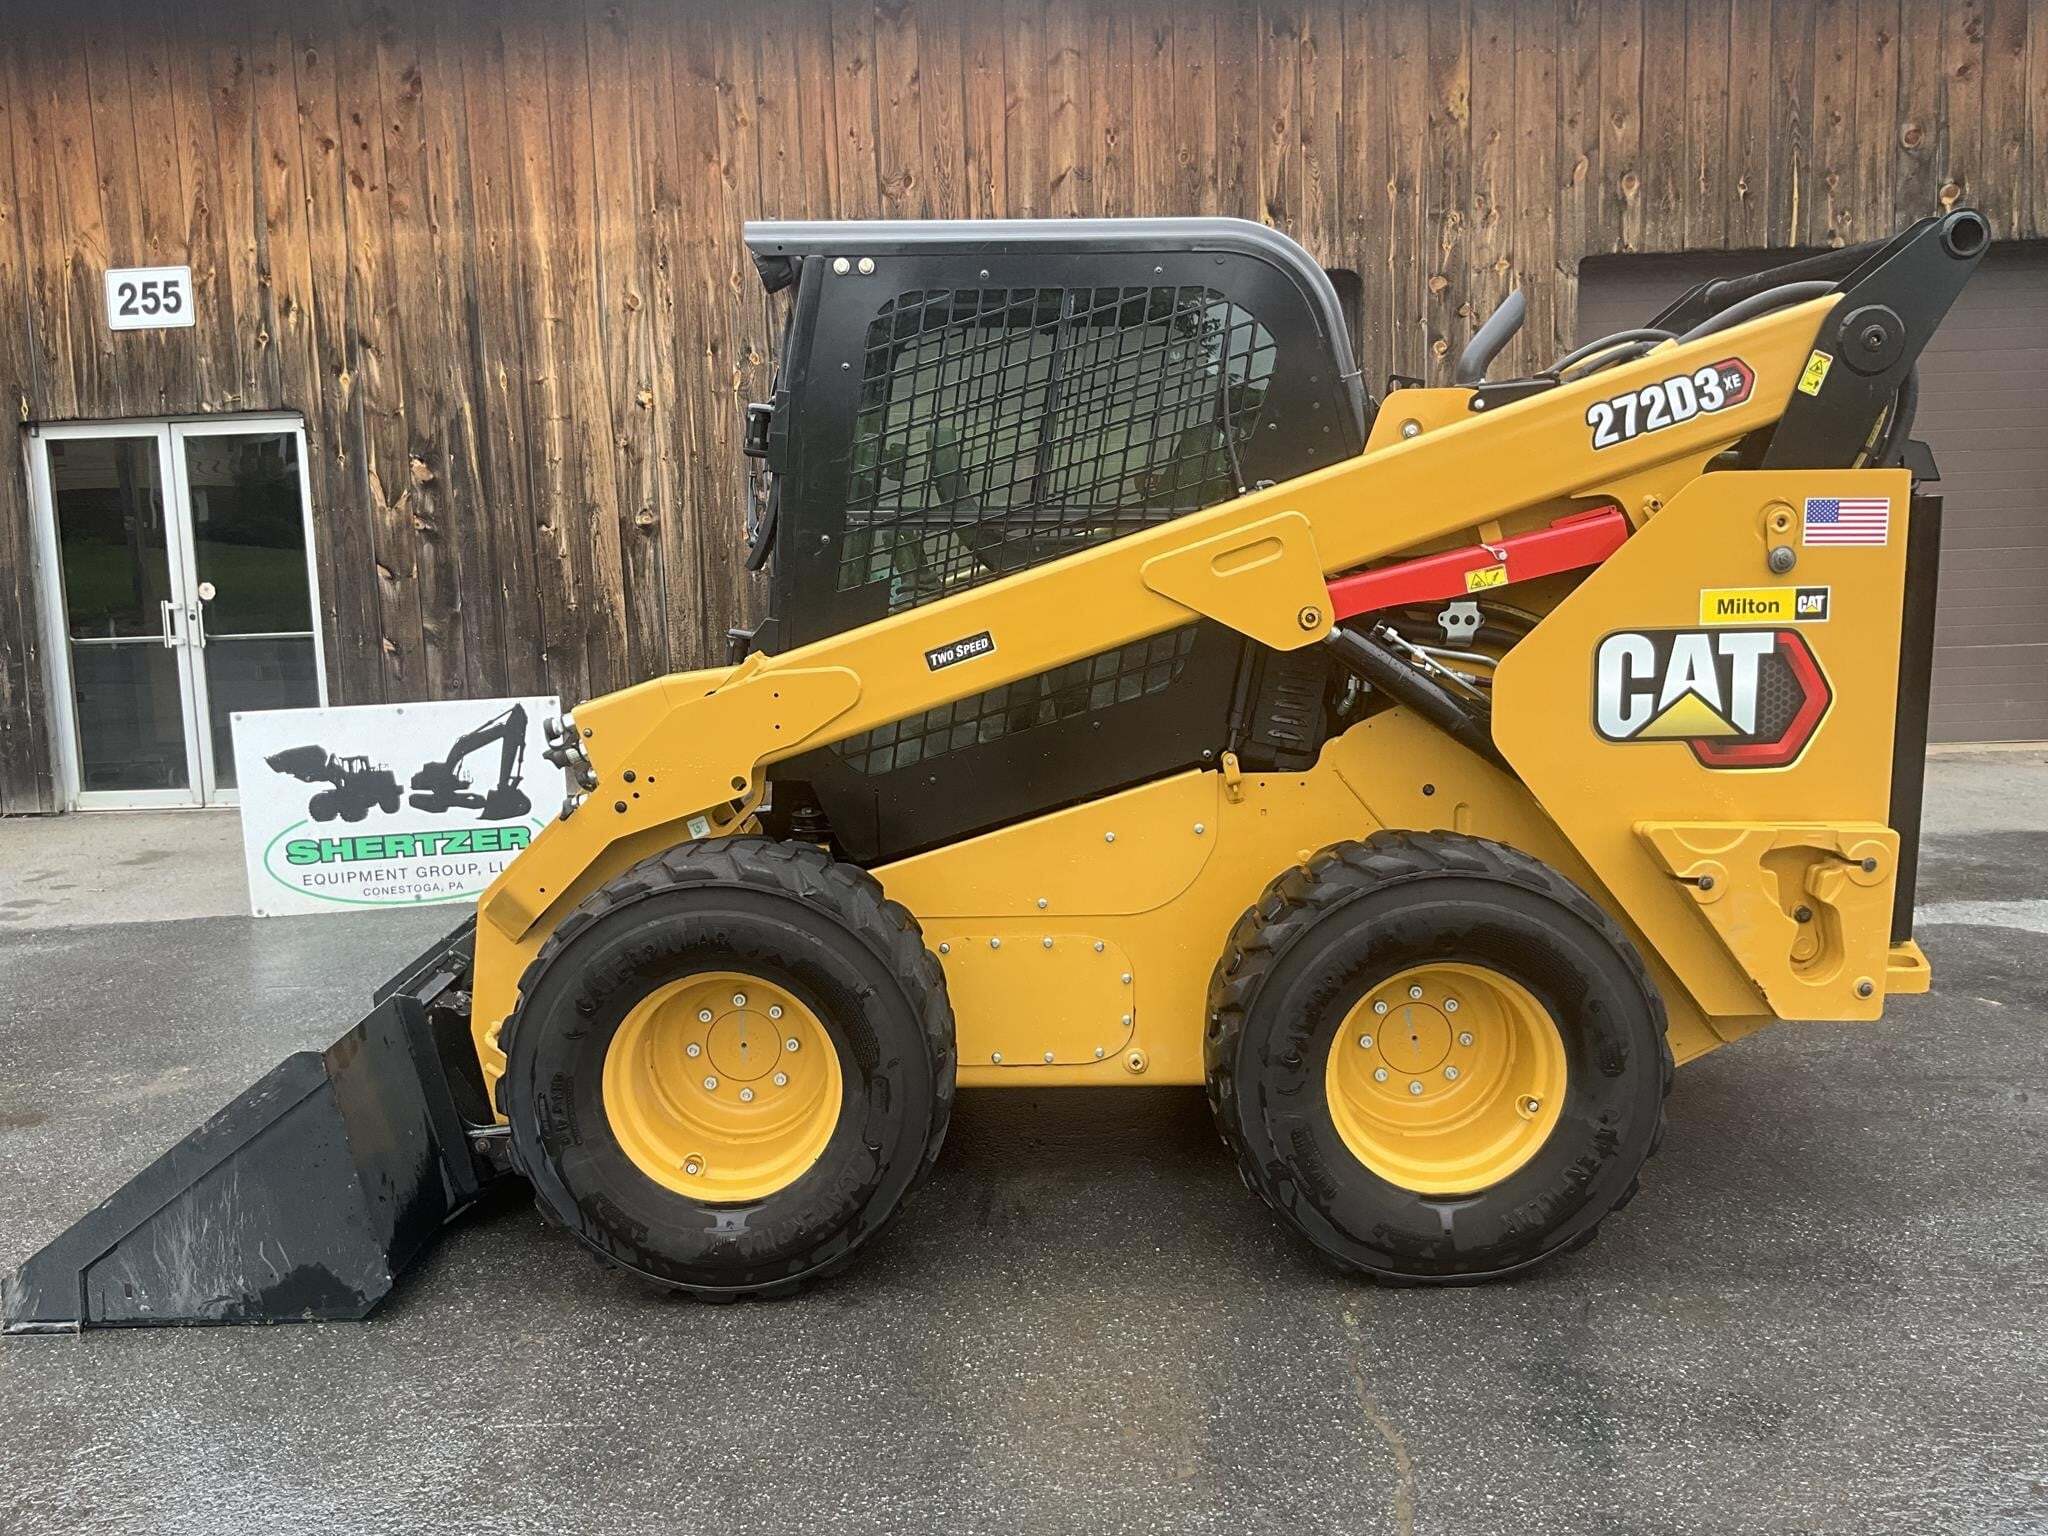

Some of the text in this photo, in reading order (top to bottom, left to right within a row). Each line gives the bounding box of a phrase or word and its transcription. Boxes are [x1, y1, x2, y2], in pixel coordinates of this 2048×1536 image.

[118, 280, 182, 316] 255
[1588, 367, 1743, 449] 272D3 XE
[1717, 595, 1826, 615] Milton CAT
[930, 638, 989, 666] TWO SPEED
[1598, 632, 1775, 738] CAT
[285, 825, 532, 866] SHERTZER
[303, 861, 504, 887] EQUIPMENT GROUP, LL
[363, 881, 464, 897] CONESTOGA, PA
